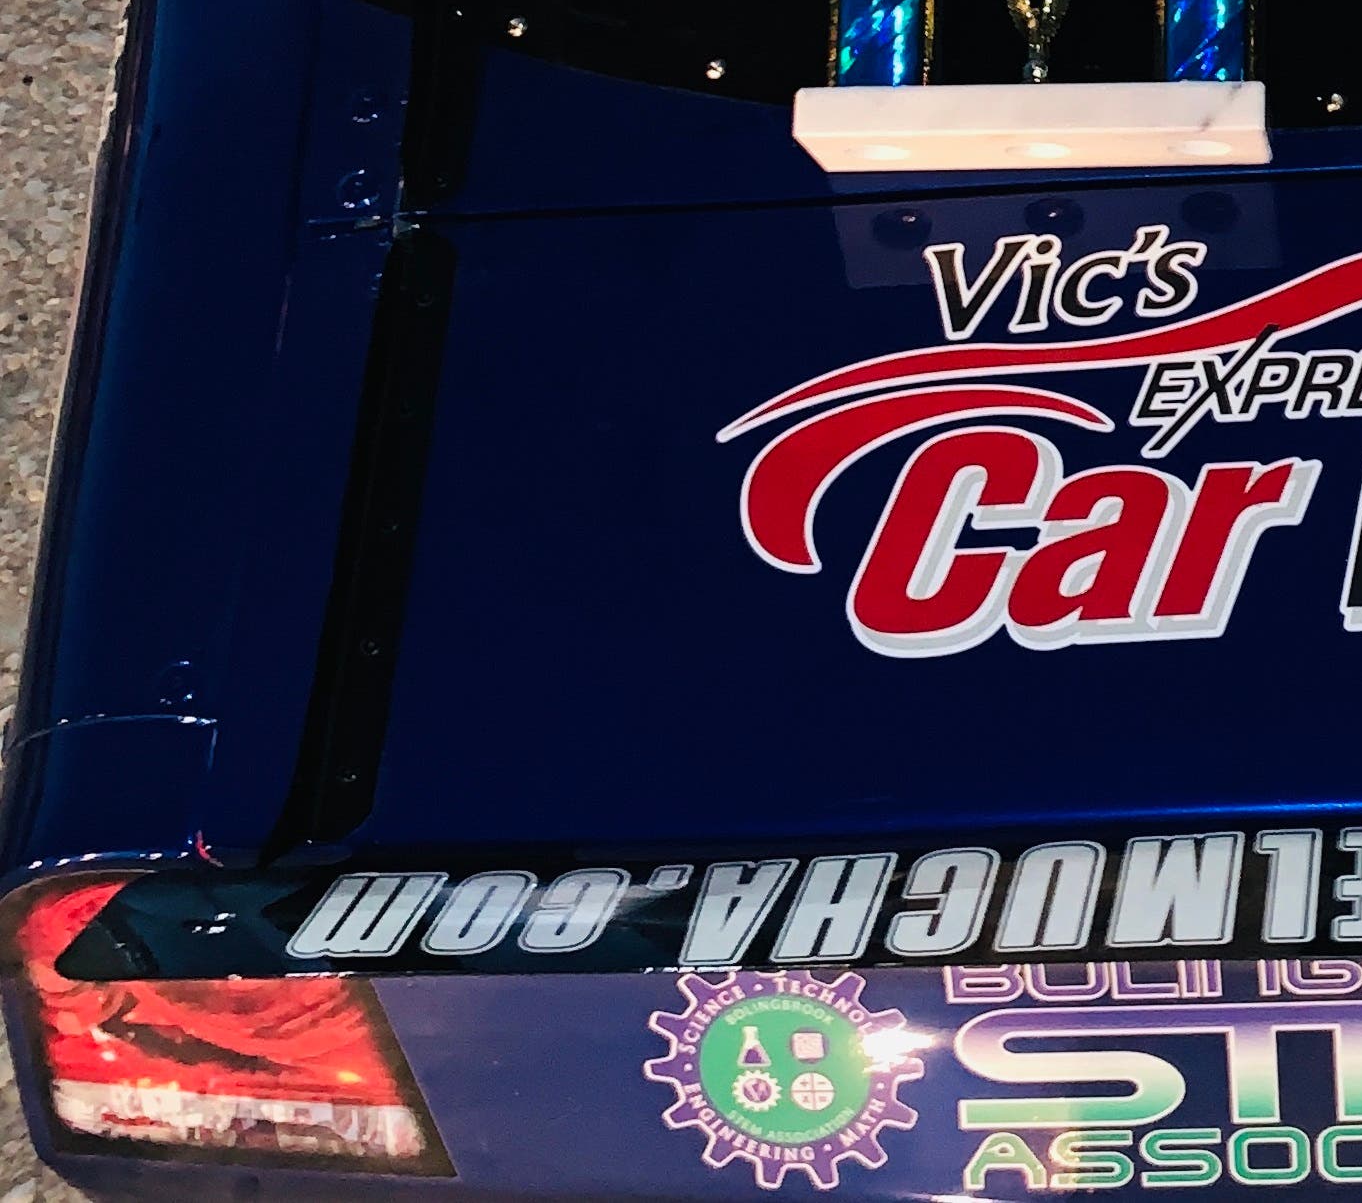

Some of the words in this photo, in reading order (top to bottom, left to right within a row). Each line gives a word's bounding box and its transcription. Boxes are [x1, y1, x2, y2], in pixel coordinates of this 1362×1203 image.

[923, 225, 1208, 340] Vic's
[847, 426, 1322, 659] Car
[676, 985, 746, 1055] SCIENCE
[774, 976, 875, 1034] TECHNOL
[724, 999, 835, 1026] BOLINGBROOK
[682, 1083, 816, 1161] ENGINEERING
[838, 1100, 887, 1148] MATH
[728, 1109, 763, 1137] STEM
[767, 1107, 857, 1142] ASSOCIATION
